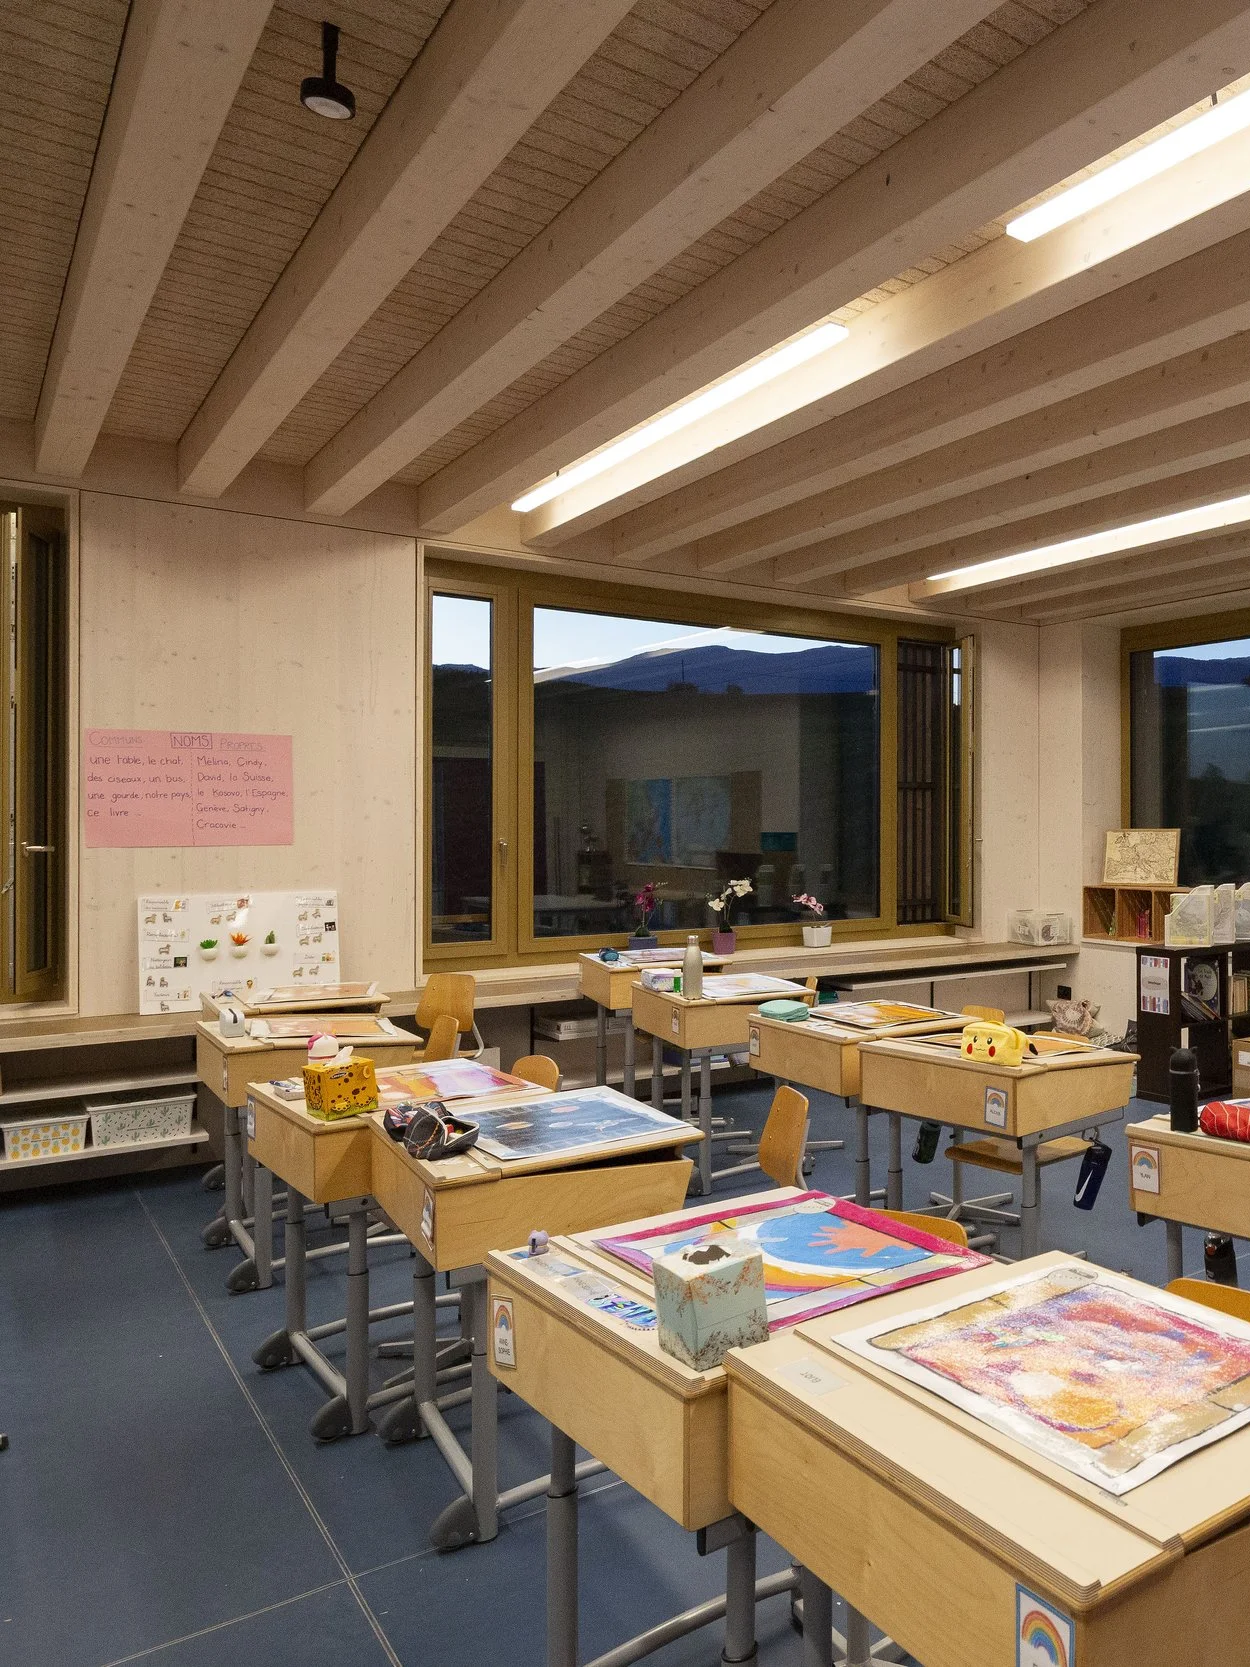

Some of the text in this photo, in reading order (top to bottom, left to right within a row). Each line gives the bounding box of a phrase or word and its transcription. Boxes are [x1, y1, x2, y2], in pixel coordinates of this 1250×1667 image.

[173, 735, 209, 747] NOMS
[90, 755, 110, 765] une
[148, 755, 156, 765] le
[87, 772, 103, 782] des
[149, 775, 161, 783] un
[229, 773, 238, 781] la
[88, 792, 105, 800] une
[145, 790, 168, 799] notre
[197, 787, 204, 797] le
[87, 809, 100, 817] ce
[110, 807, 129, 817] livre
[196, 819, 237, 829] Cracovie
